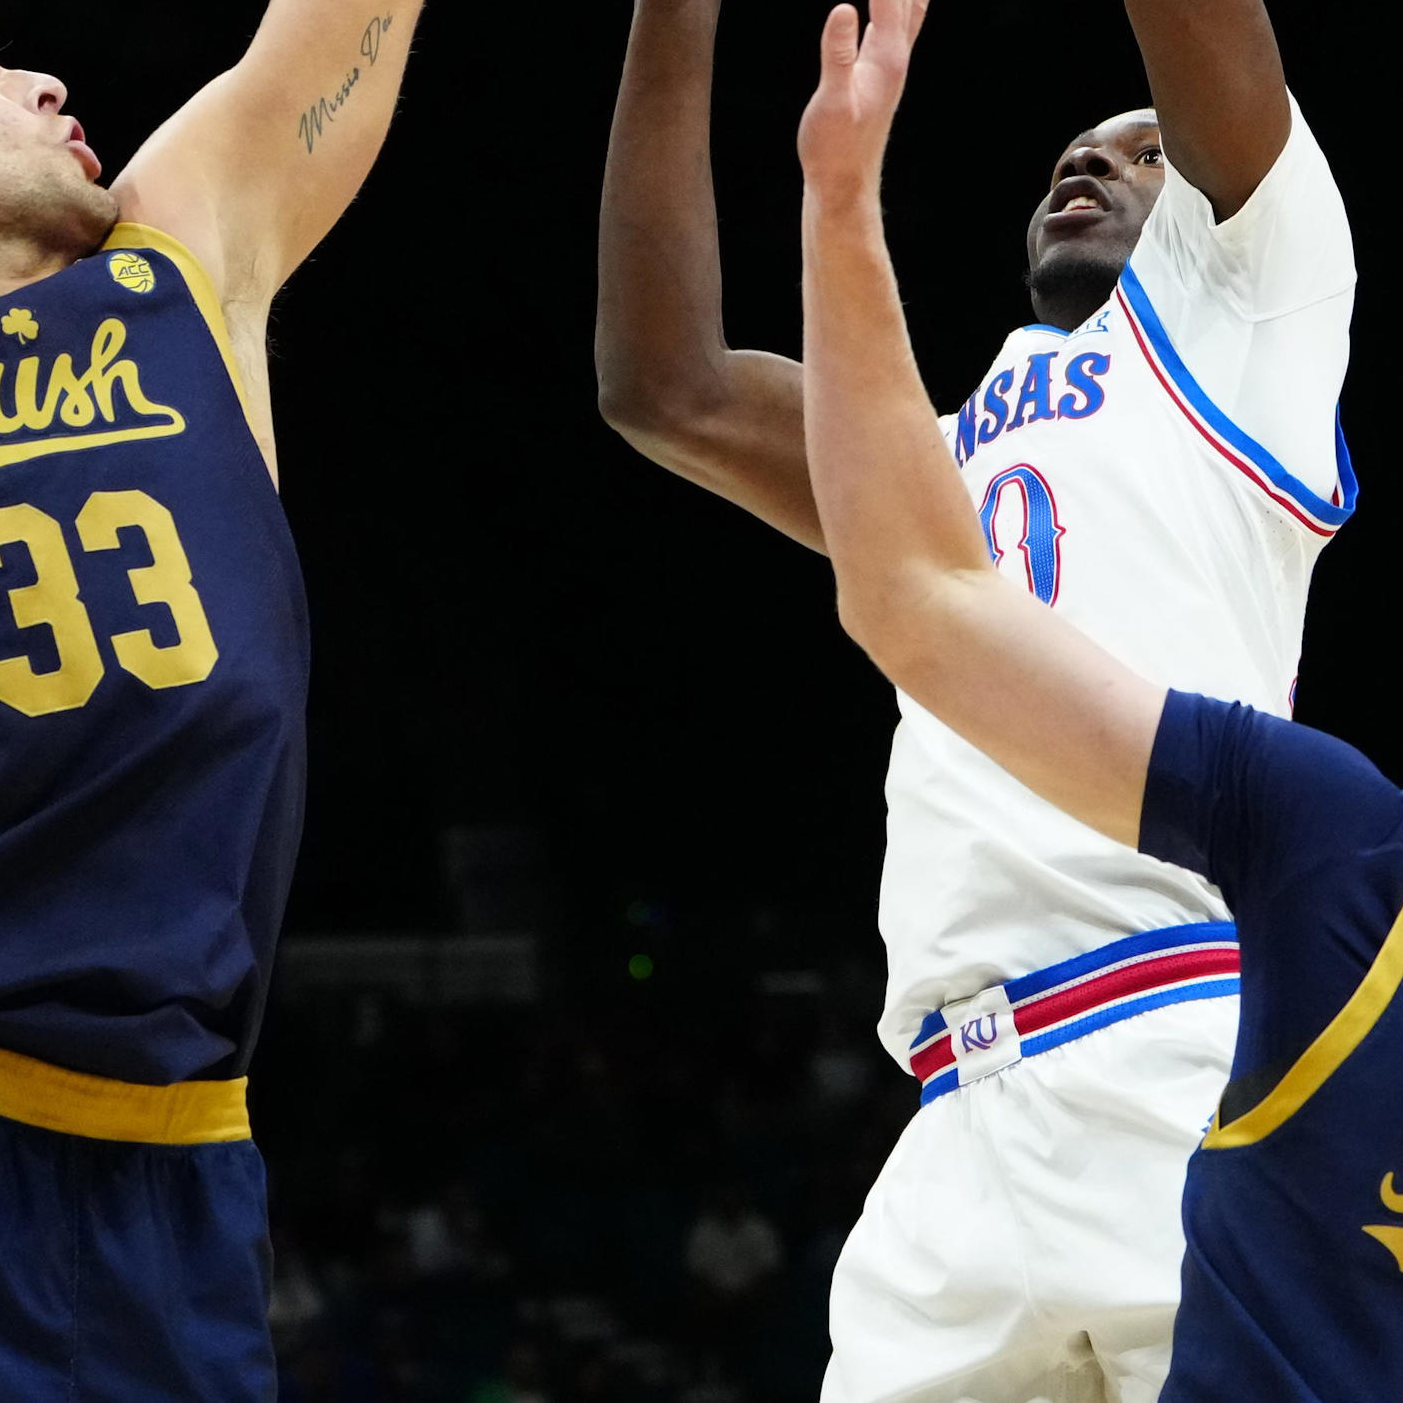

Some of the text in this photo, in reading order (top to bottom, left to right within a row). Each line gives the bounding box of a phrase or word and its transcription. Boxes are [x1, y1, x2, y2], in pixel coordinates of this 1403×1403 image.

[117, 262, 150, 277] ACC
[954, 351, 1111, 469] NSAS
[960, 1012, 997, 1053] KU
